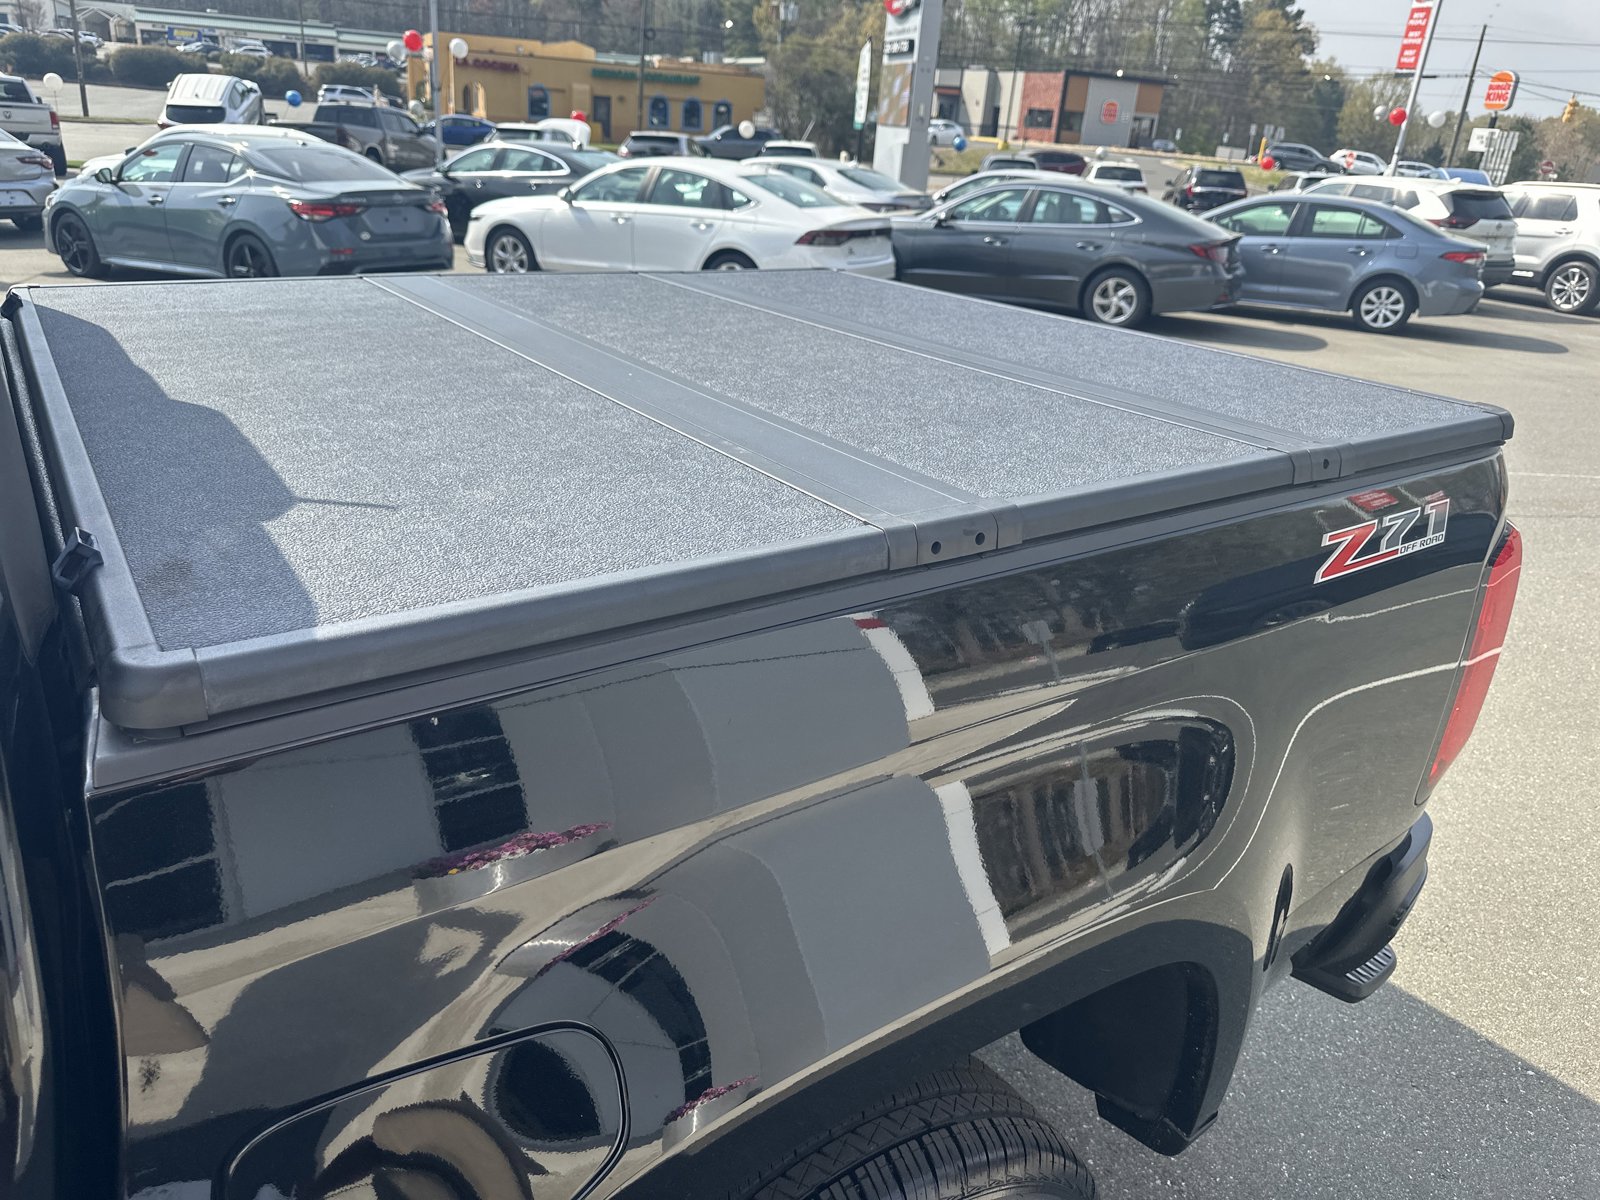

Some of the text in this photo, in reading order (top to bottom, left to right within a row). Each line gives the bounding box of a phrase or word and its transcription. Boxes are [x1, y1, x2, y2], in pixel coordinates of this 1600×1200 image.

[1488, 83, 1512, 91] BURGER
[1485, 91, 1509, 102] KING
[1313, 498, 1450, 584] Z71
[1400, 533, 1444, 554] OFF ROAD
